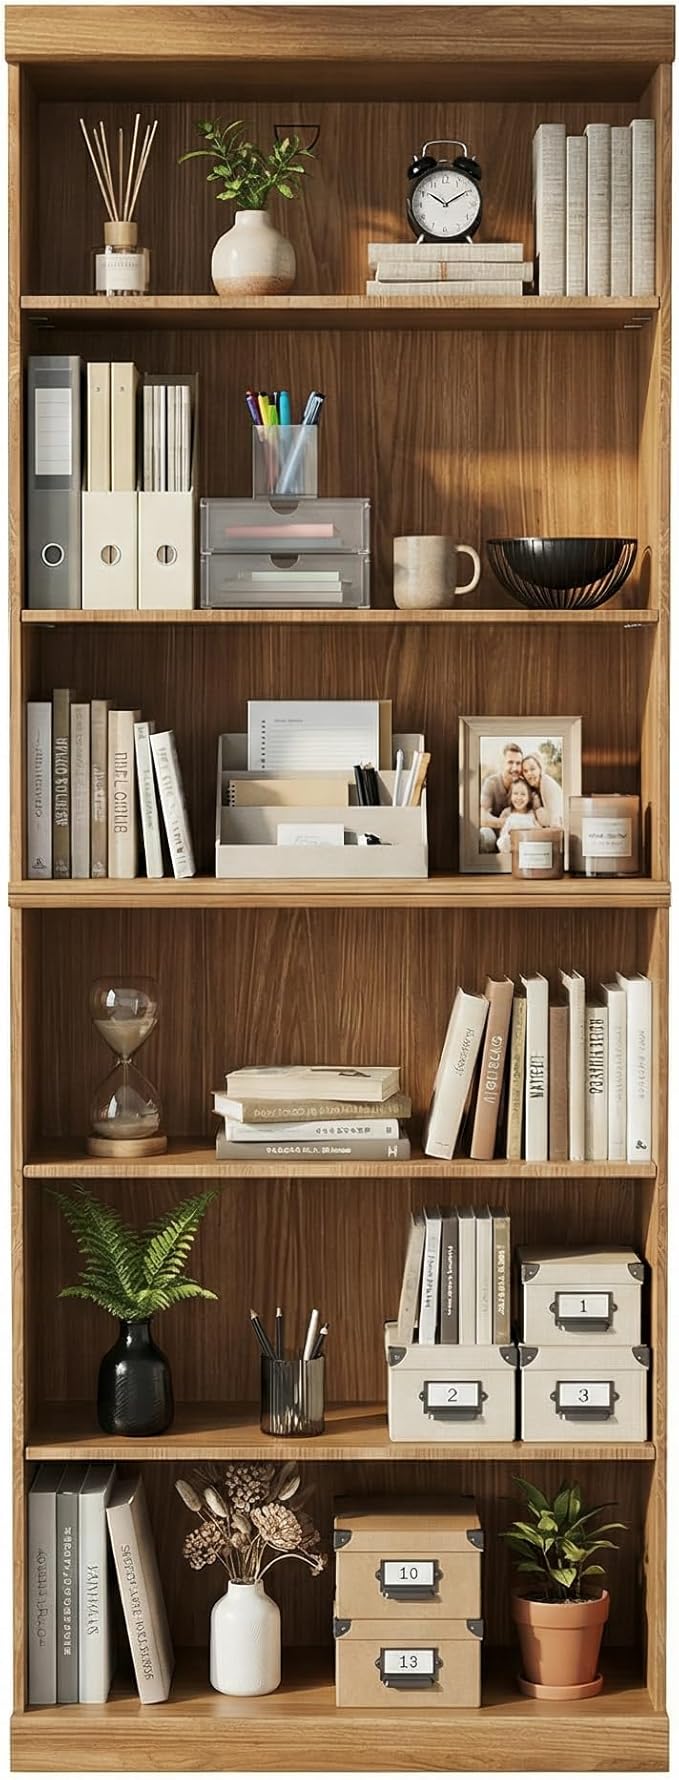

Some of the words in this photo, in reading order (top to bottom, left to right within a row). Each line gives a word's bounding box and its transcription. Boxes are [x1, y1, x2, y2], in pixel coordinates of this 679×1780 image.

[579, 1299, 587, 1313] 1
[447, 1388, 458, 1402] 2
[578, 1388, 589, 1403] 3
[399, 1567, 418, 1580] 10
[399, 1655, 418, 1669] 13
